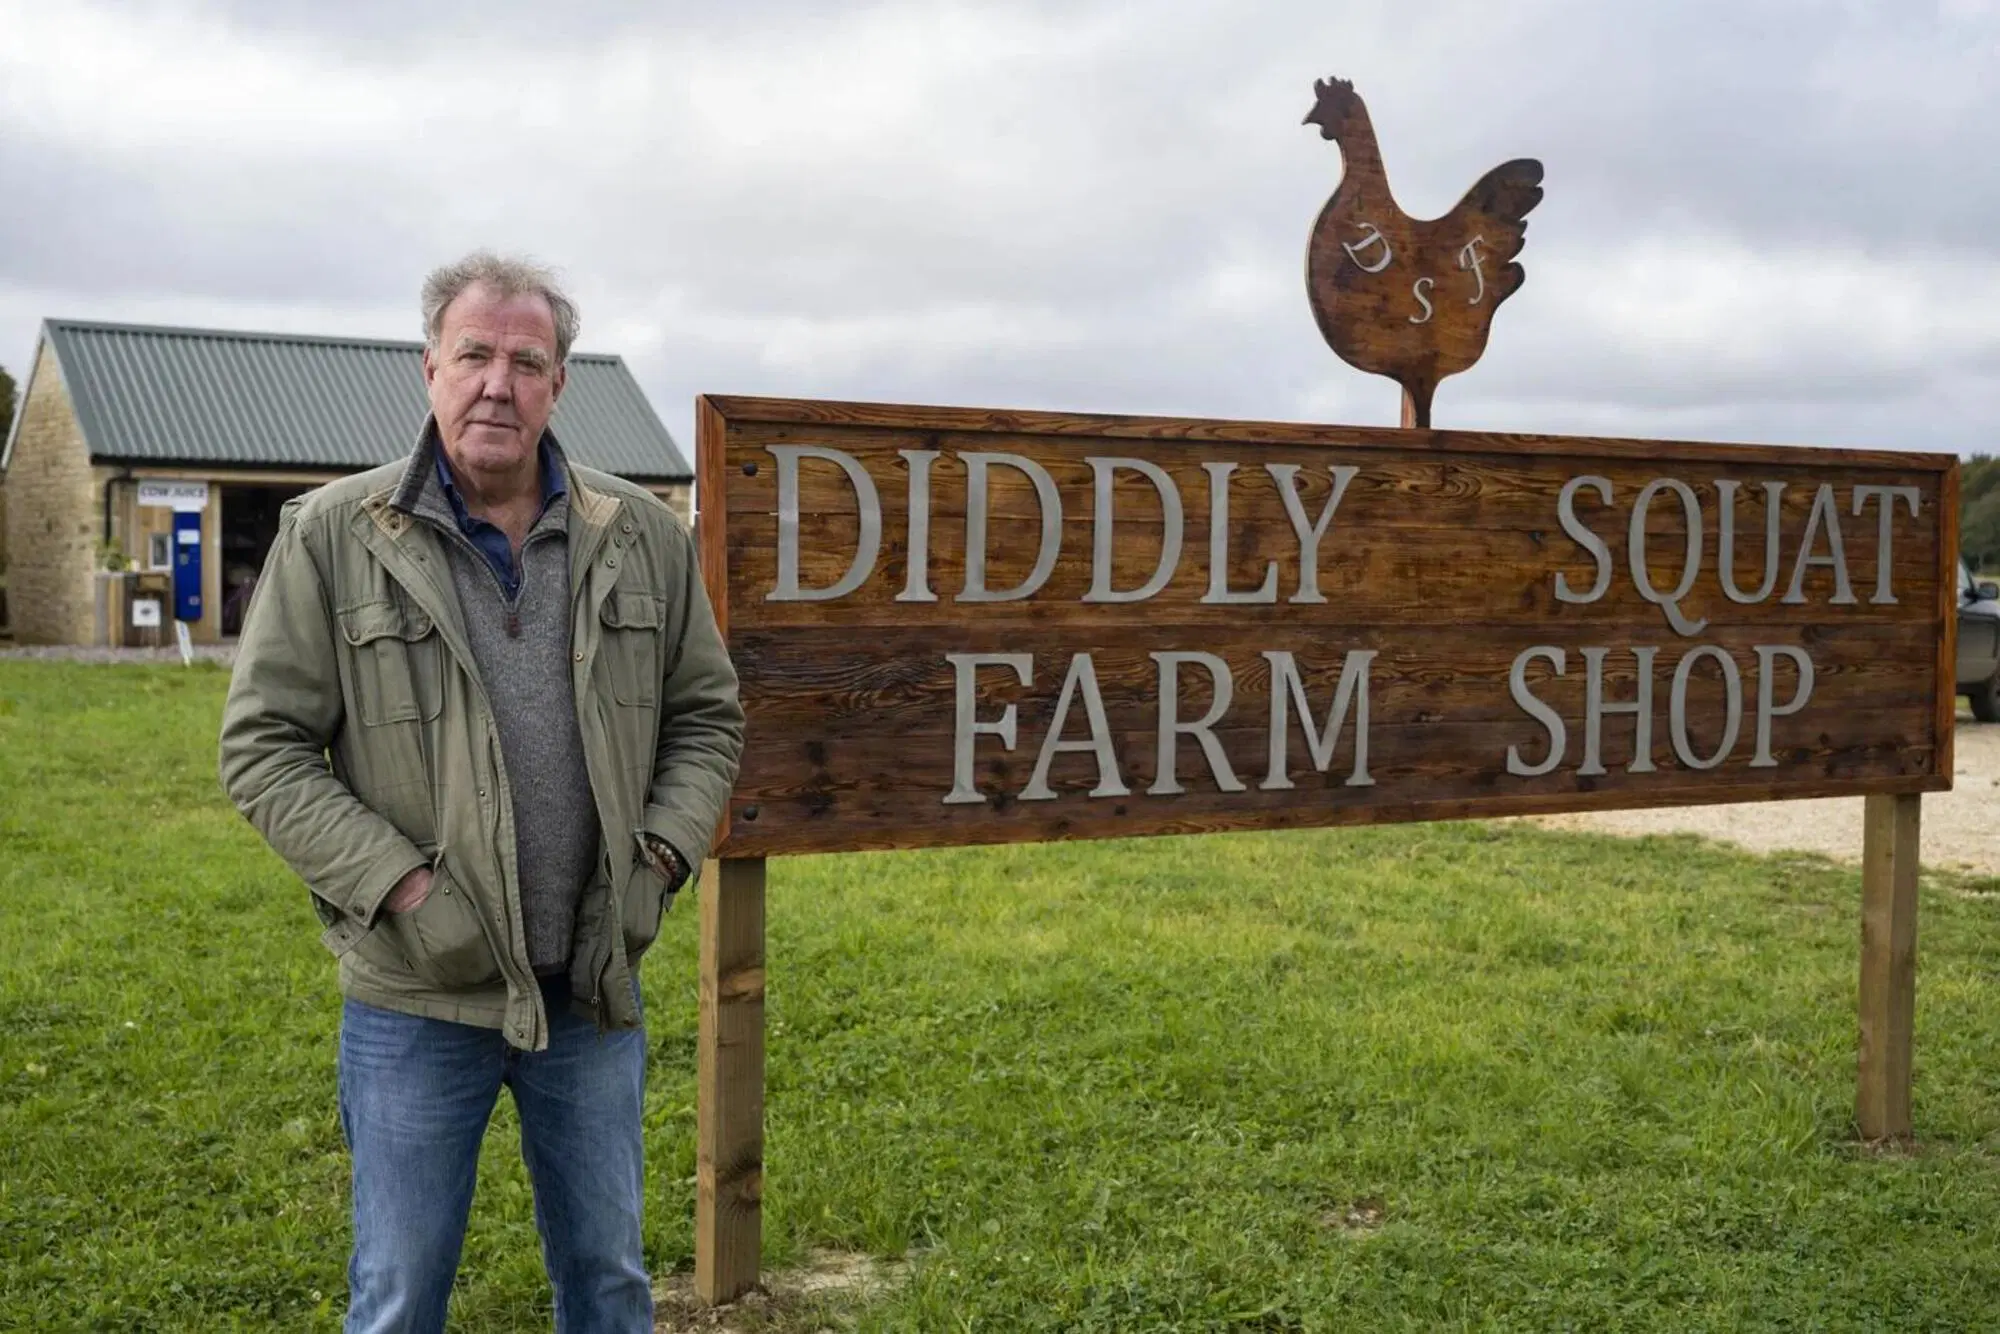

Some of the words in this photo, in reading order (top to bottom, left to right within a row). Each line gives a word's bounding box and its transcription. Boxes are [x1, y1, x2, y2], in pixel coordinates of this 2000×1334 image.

[1341, 222, 1393, 274] D
[1408, 276, 1434, 324] S
[765, 443, 1360, 604] DIDDLY
[1553, 474, 1921, 637] SQUAT
[942, 649, 1379, 804] FARM
[1506, 643, 1815, 776] SHOP
